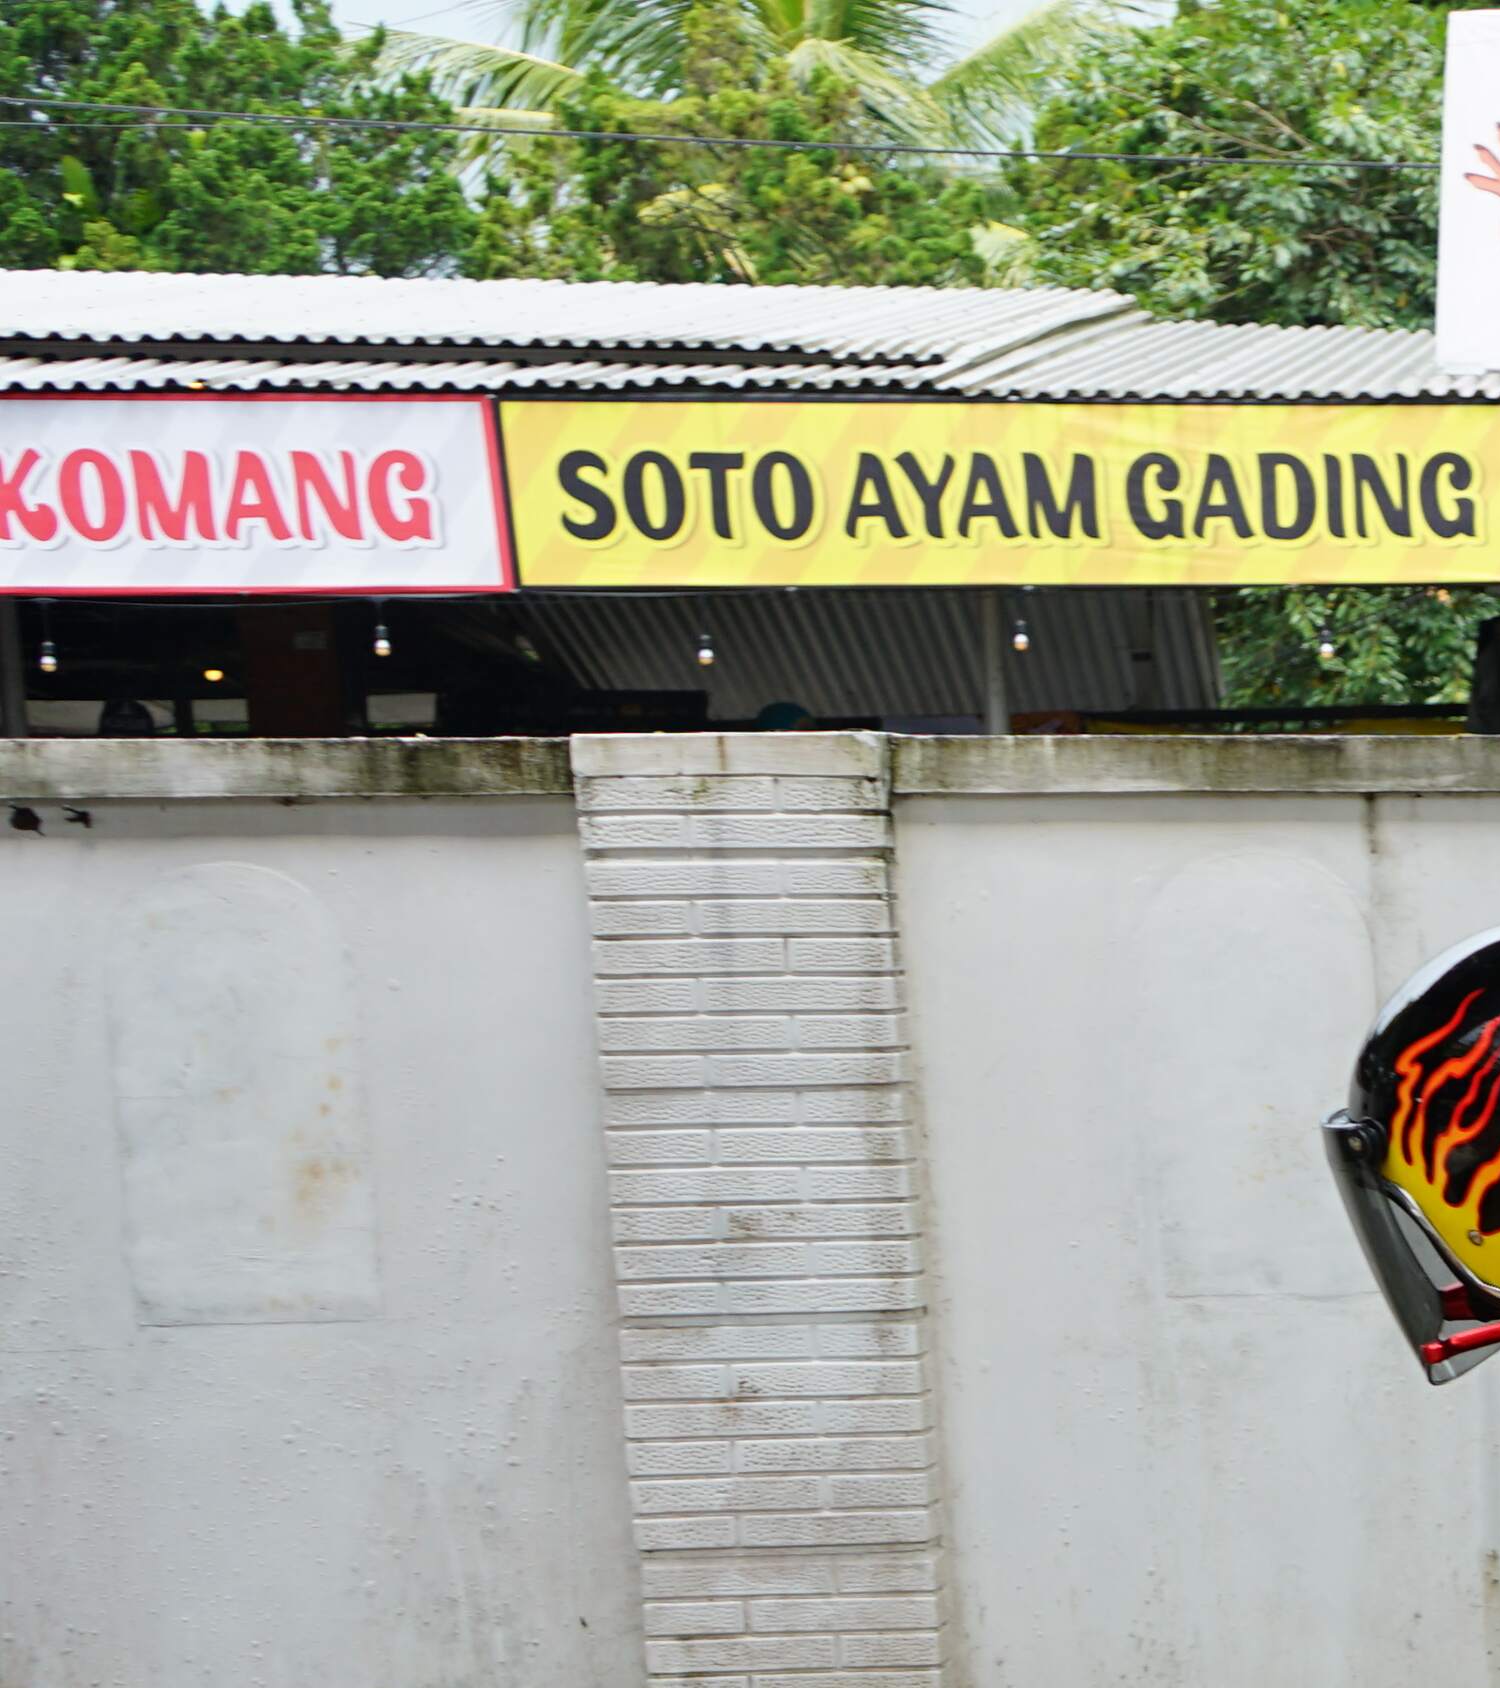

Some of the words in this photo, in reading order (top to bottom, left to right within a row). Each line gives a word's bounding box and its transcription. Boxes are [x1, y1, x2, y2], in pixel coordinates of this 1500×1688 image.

[557, 449, 815, 542] SOTO
[844, 451, 1100, 540] AYAM
[1125, 451, 1476, 541] GADING
